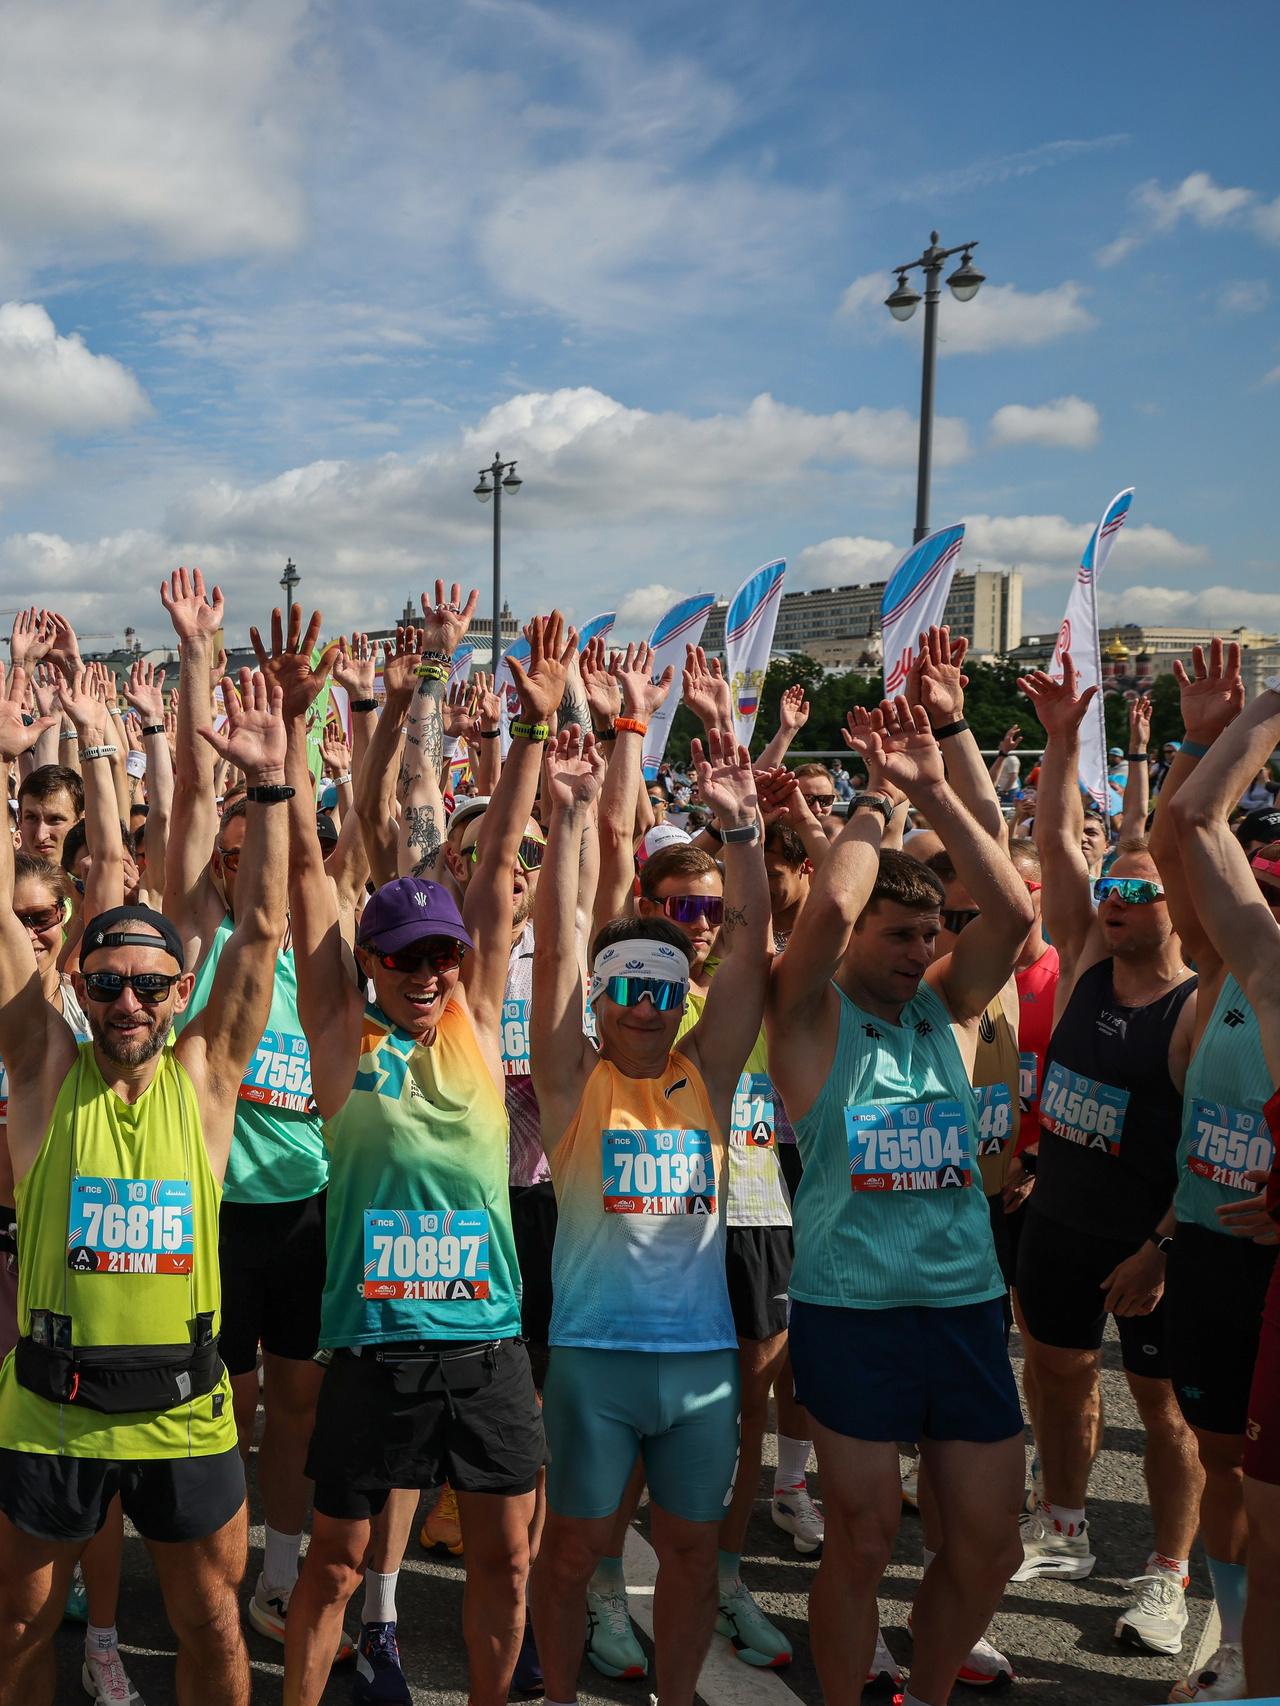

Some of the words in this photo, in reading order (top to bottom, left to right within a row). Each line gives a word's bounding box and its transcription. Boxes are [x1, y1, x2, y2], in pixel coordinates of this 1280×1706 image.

[860, 1114, 877, 1122] ПСБ
[1044, 1080, 1117, 1137] 74566
[753, 1122, 769, 1140] A
[857, 1126, 963, 1170] 75504
[984, 1138, 1001, 1154] A
[1089, 1134, 1108, 1153] A
[1197, 1120, 1276, 1173] 7550
[613, 1153, 707, 1193] 70138
[891, 1171, 938, 1191] 21.1KM
[940, 1166, 962, 1188] A
[85, 1186, 102, 1194] ПСБ
[642, 1196, 687, 1215] 21.1KM
[693, 1196, 710, 1214] A
[82, 1202, 183, 1250] 76815
[378, 1219, 395, 1227] ПСБ
[76, 1249, 90, 1263] A
[107, 1251, 157, 1274] 21.1KM
[373, 1235, 480, 1278] 70897
[451, 1280, 472, 1299] A
